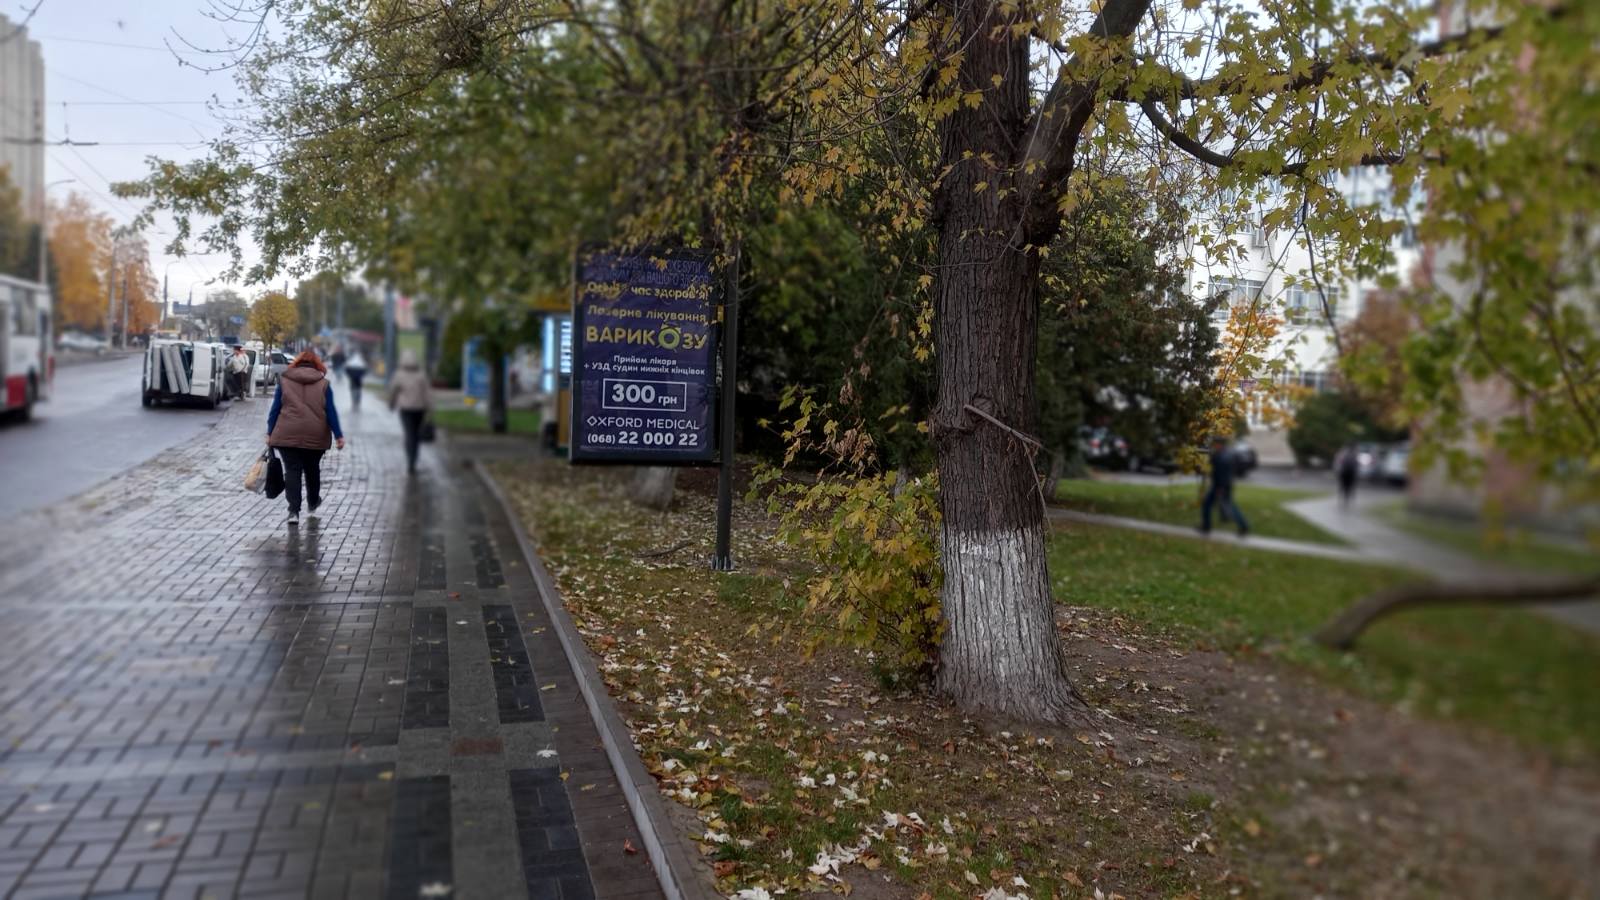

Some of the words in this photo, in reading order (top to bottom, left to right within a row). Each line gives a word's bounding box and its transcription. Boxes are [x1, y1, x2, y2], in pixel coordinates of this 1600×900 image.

[631, 286, 651, 296] час
[646, 309, 706, 323] лікування
[586, 325, 708, 350] ВАРИКОЗУ
[613, 355, 647, 365] Прийом
[649, 357, 677, 366] лікаря
[592, 362, 611, 371] УЗД
[612, 364, 638, 373] судин
[671, 366, 705, 375] кінцівок
[611, 383, 656, 403] 300
[658, 396, 678, 406] грн
[646, 418, 700, 430] MEDICAL
[587, 433, 616, 444] (068)
[618, 431, 639, 444] 22
[643, 432, 674, 445] 000
[678, 433, 698, 446] 22
